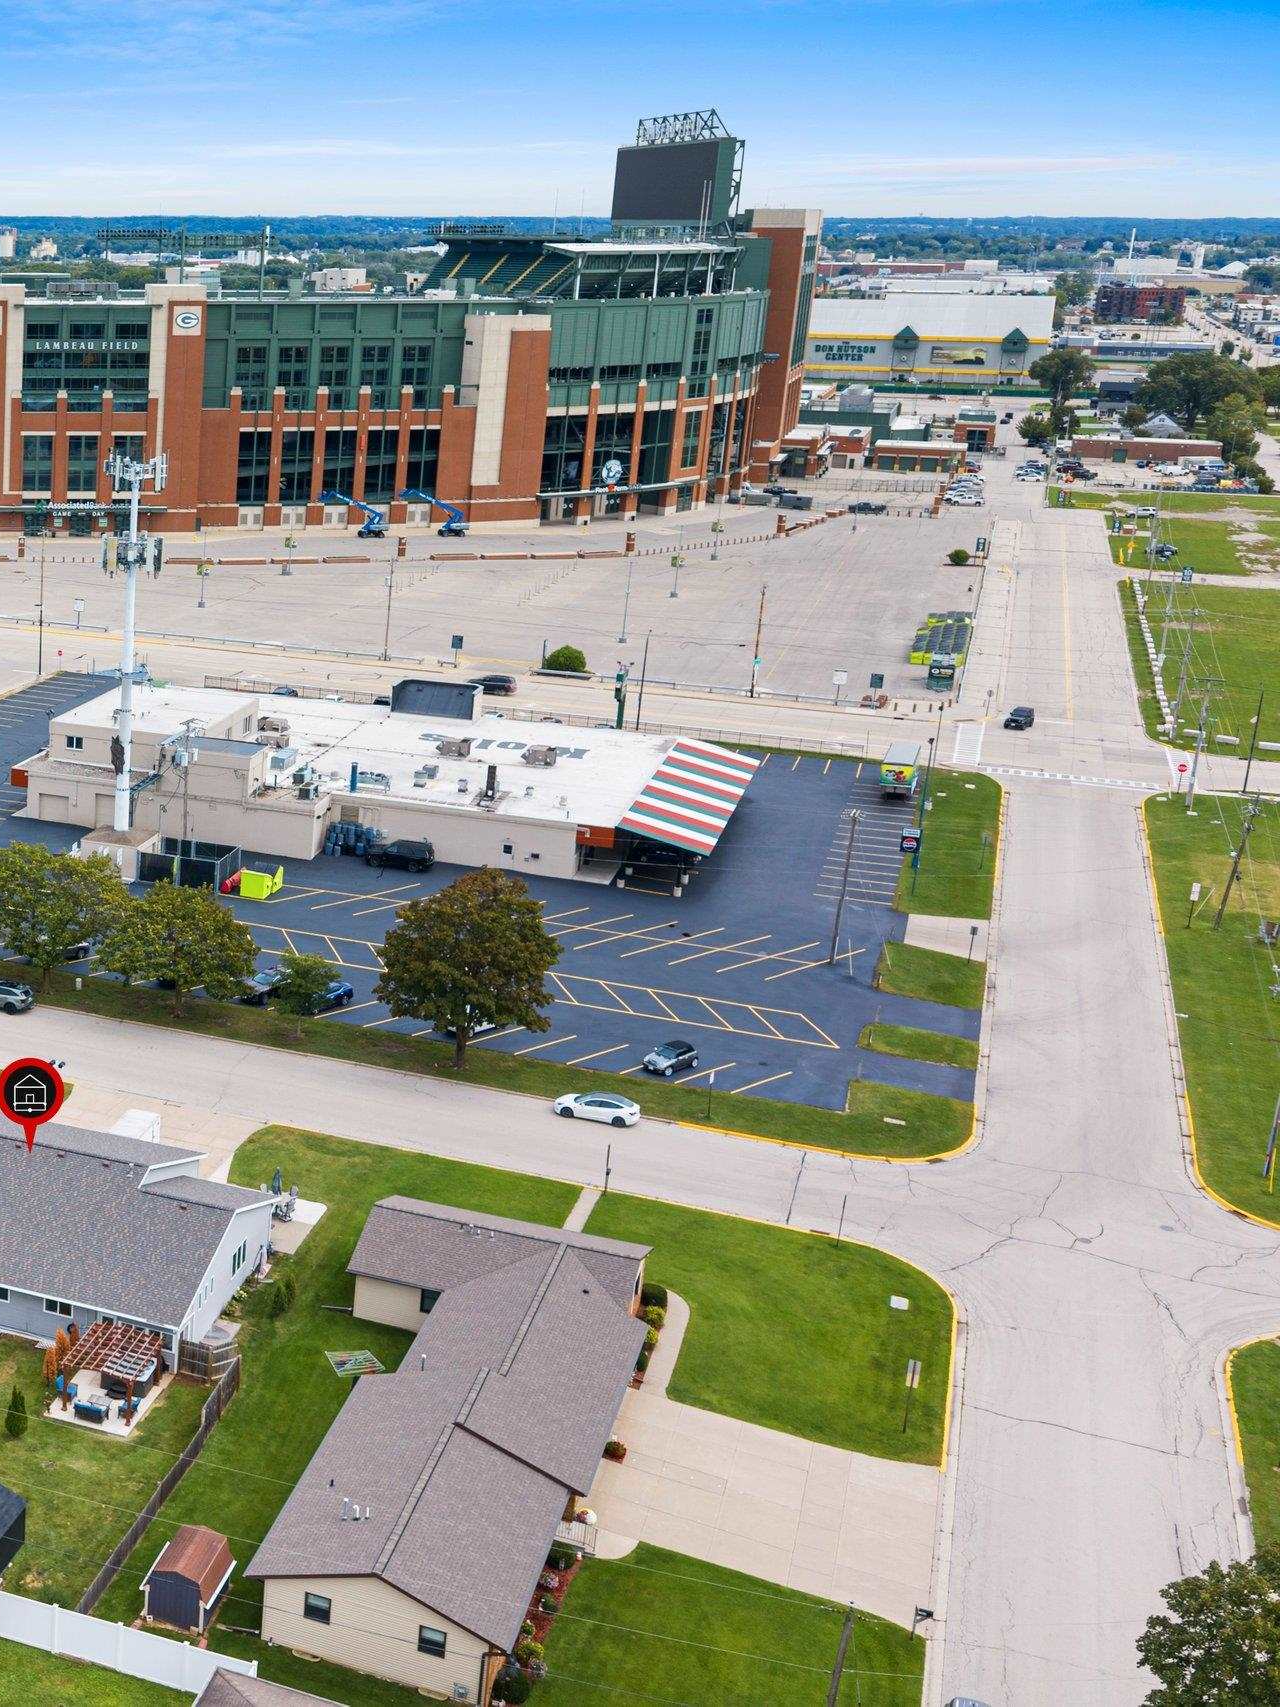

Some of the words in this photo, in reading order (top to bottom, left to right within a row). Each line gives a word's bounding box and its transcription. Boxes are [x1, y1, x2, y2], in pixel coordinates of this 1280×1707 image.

[36, 341, 94, 350] LAMBEAU
[102, 341, 138, 350] FIELD
[815, 344, 834, 353] DON
[836, 345, 876, 354] HUTSON
[825, 352, 864, 362] CENTER
